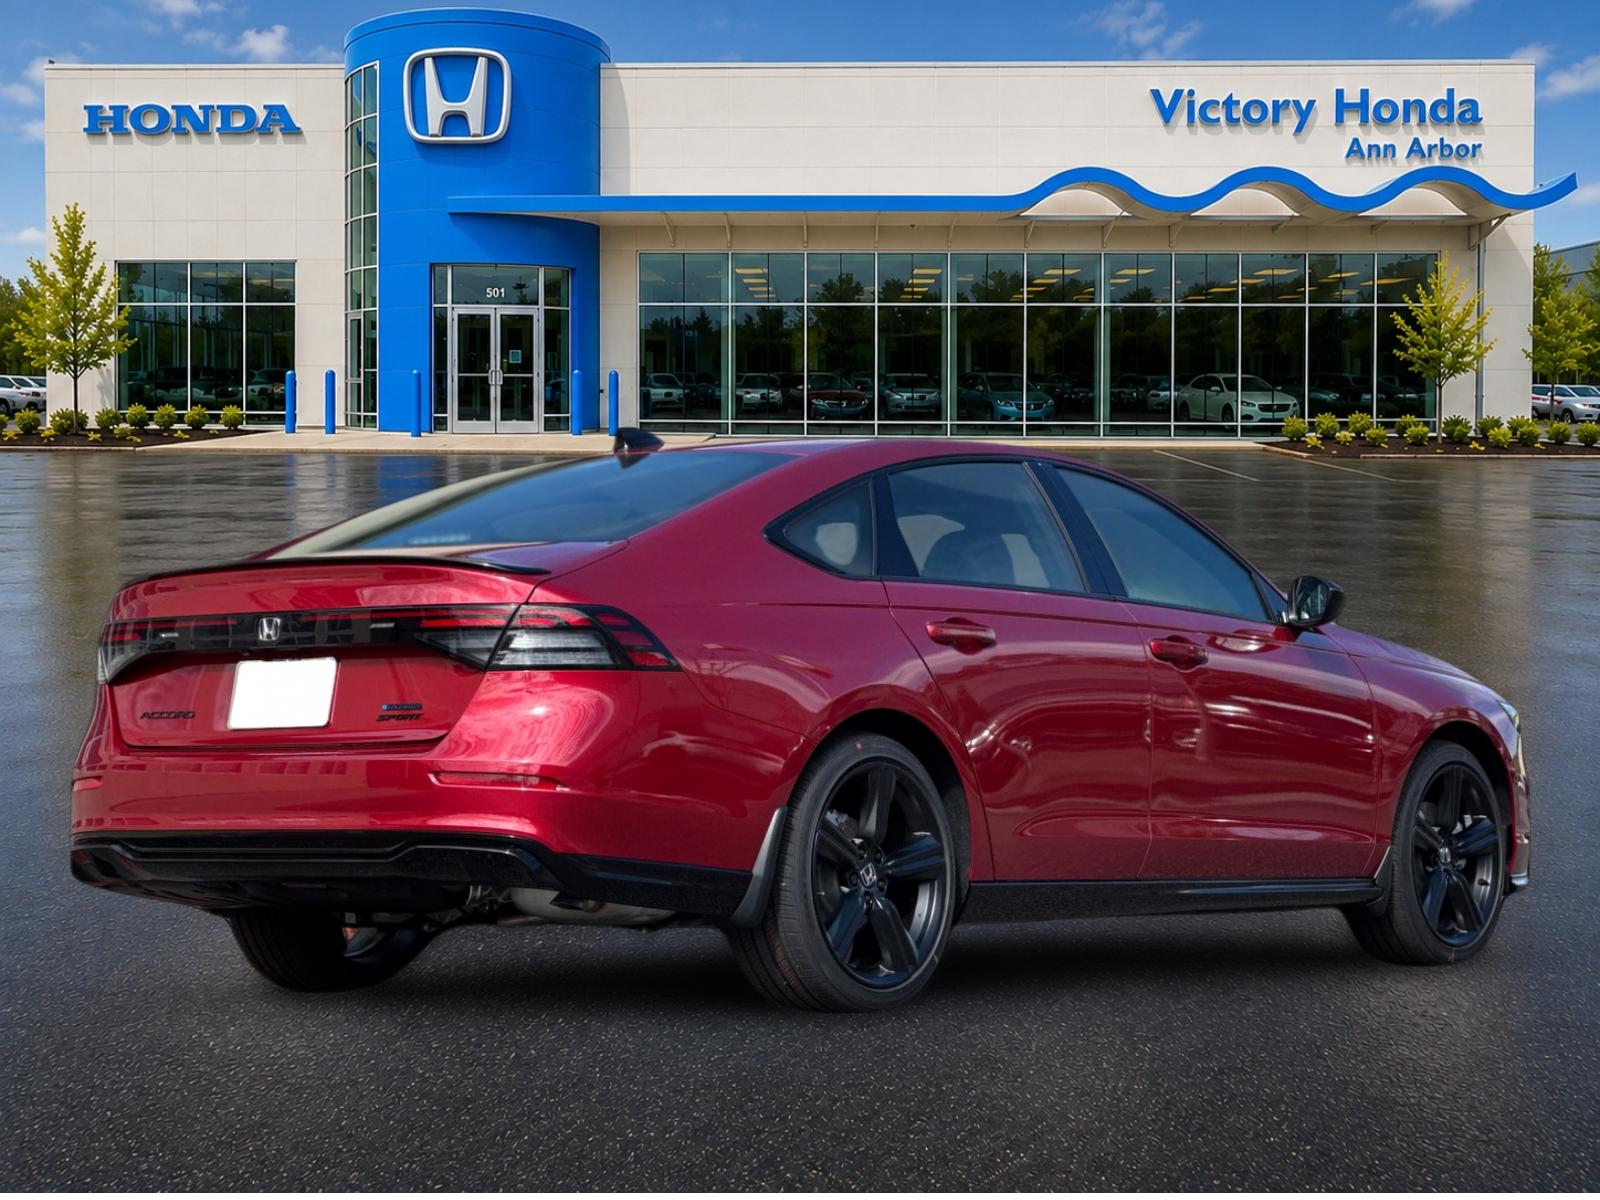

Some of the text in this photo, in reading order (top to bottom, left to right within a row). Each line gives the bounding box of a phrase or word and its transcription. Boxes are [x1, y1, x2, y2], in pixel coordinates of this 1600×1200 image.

[83, 104, 302, 136] HONDA
[1150, 87, 1483, 135] Victory Honda
[1345, 137, 1482, 160] Ann Arbor
[485, 287, 505, 298] 501
[140, 711, 196, 720] ACCORD
